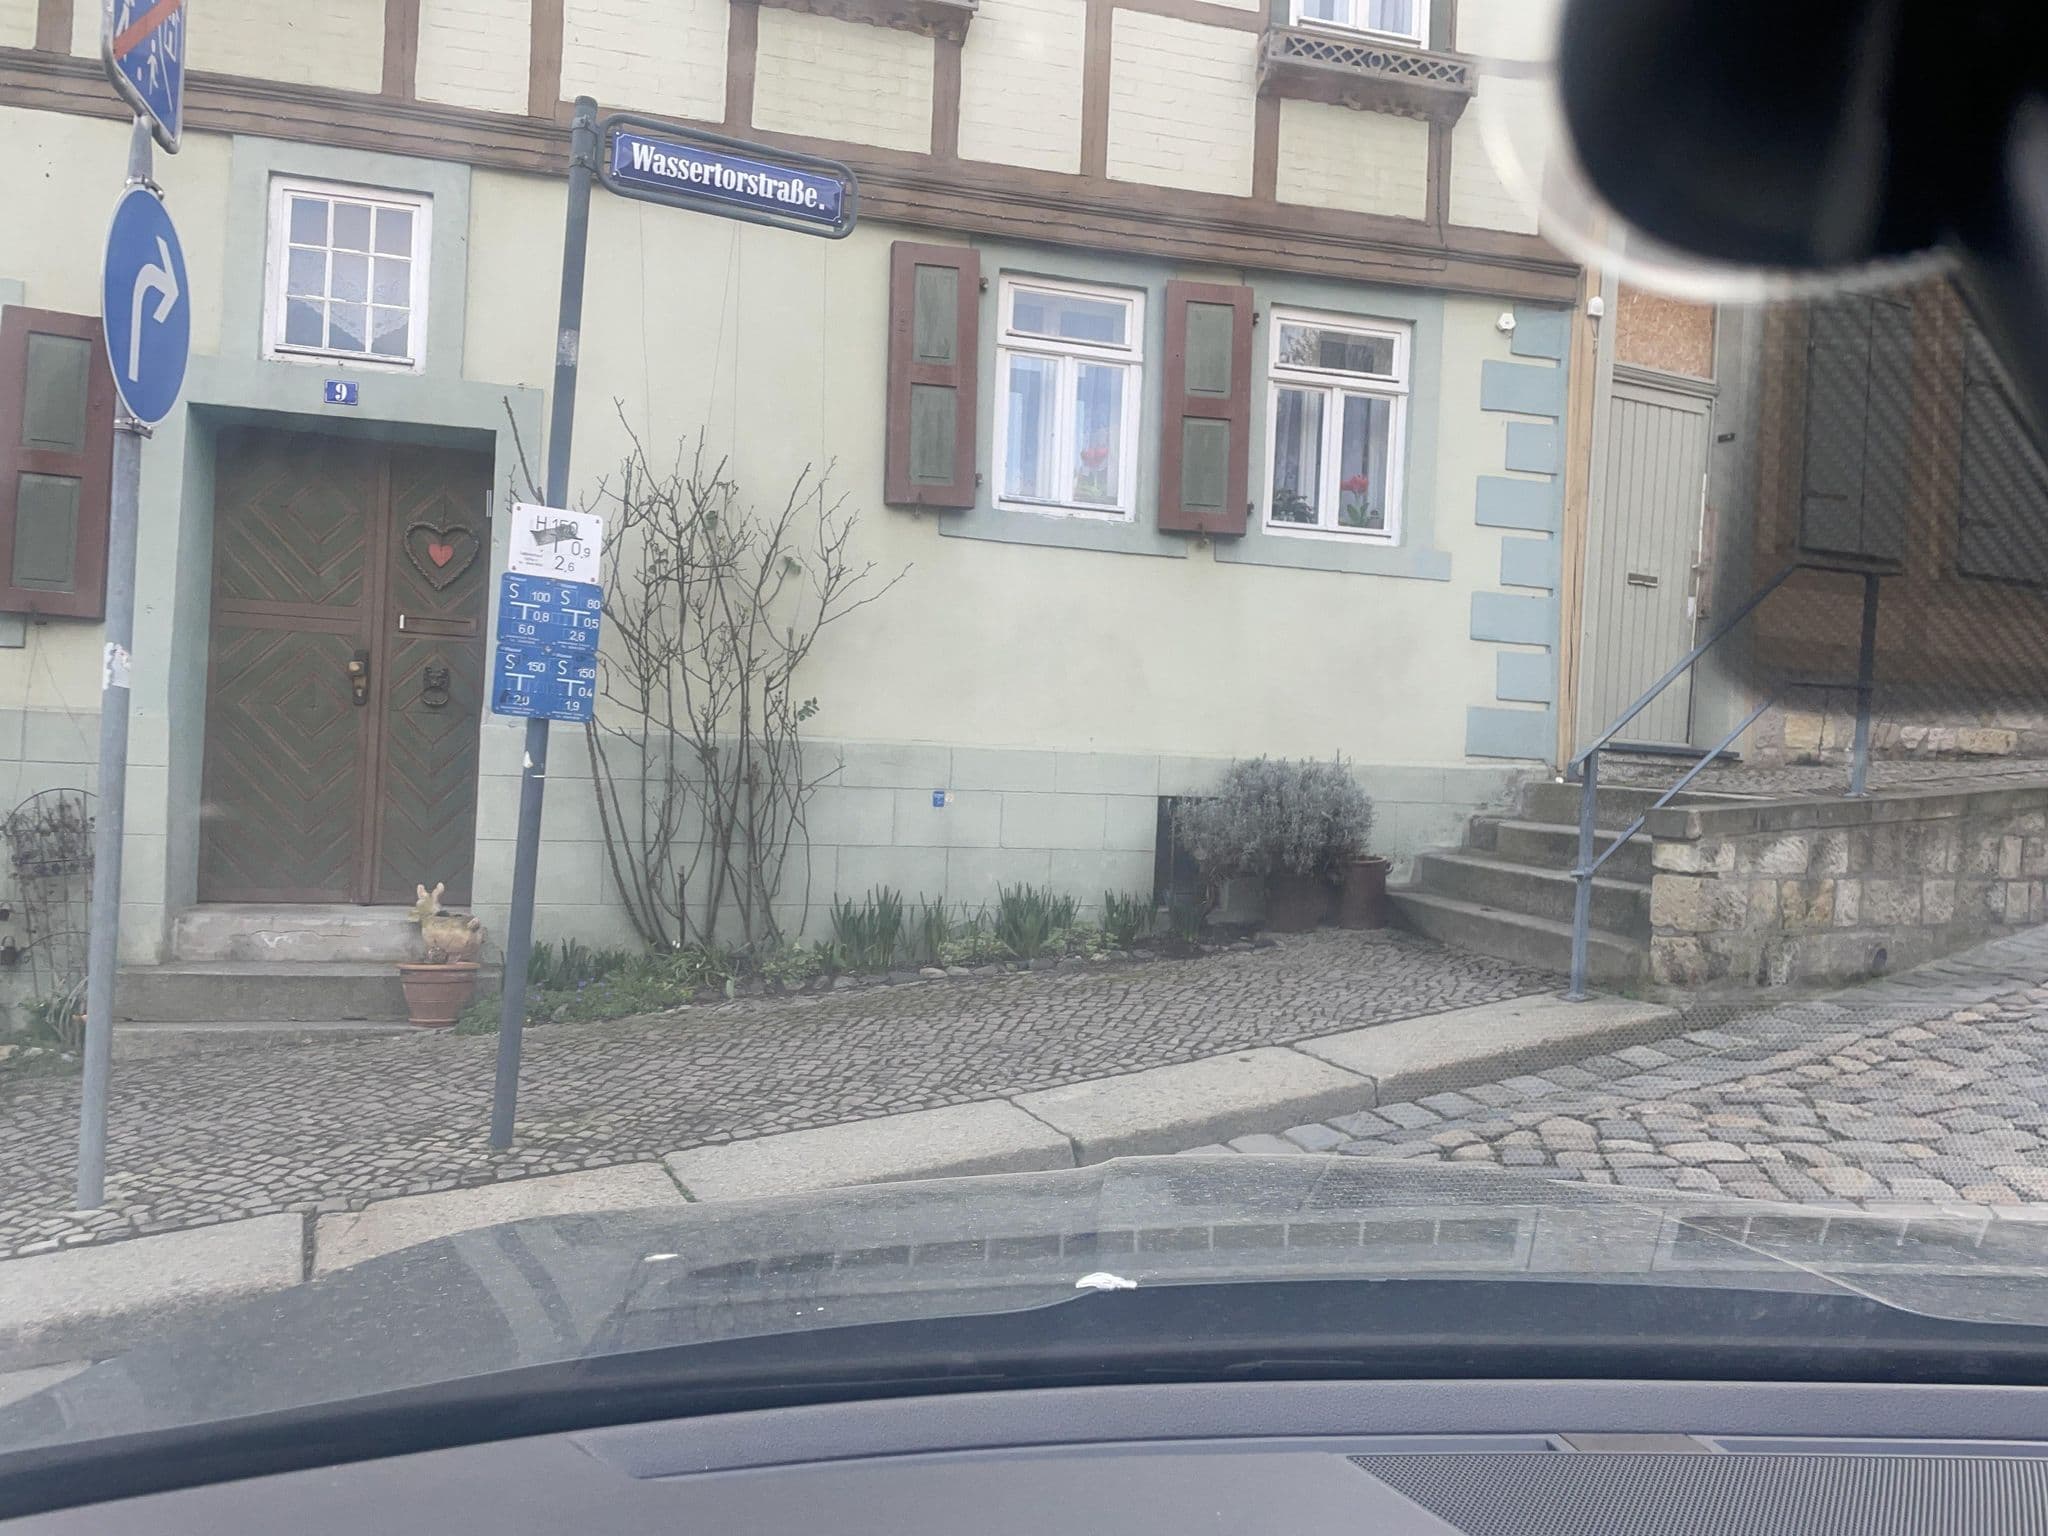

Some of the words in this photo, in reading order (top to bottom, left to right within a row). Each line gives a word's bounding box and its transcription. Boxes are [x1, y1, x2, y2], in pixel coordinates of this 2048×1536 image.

[631, 142, 825, 211] Wassertorstraße.
[335, 383, 348, 401] 9
[536, 516, 548, 532] H
[554, 555, 575, 573] 2,6
[509, 583, 520, 599] S
[531, 591, 551, 603] 100
[560, 590, 571, 605] S
[587, 599, 600, 610] 80
[505, 654, 516, 669] S
[527, 661, 546, 673] 150
[558, 660, 569, 675] S
